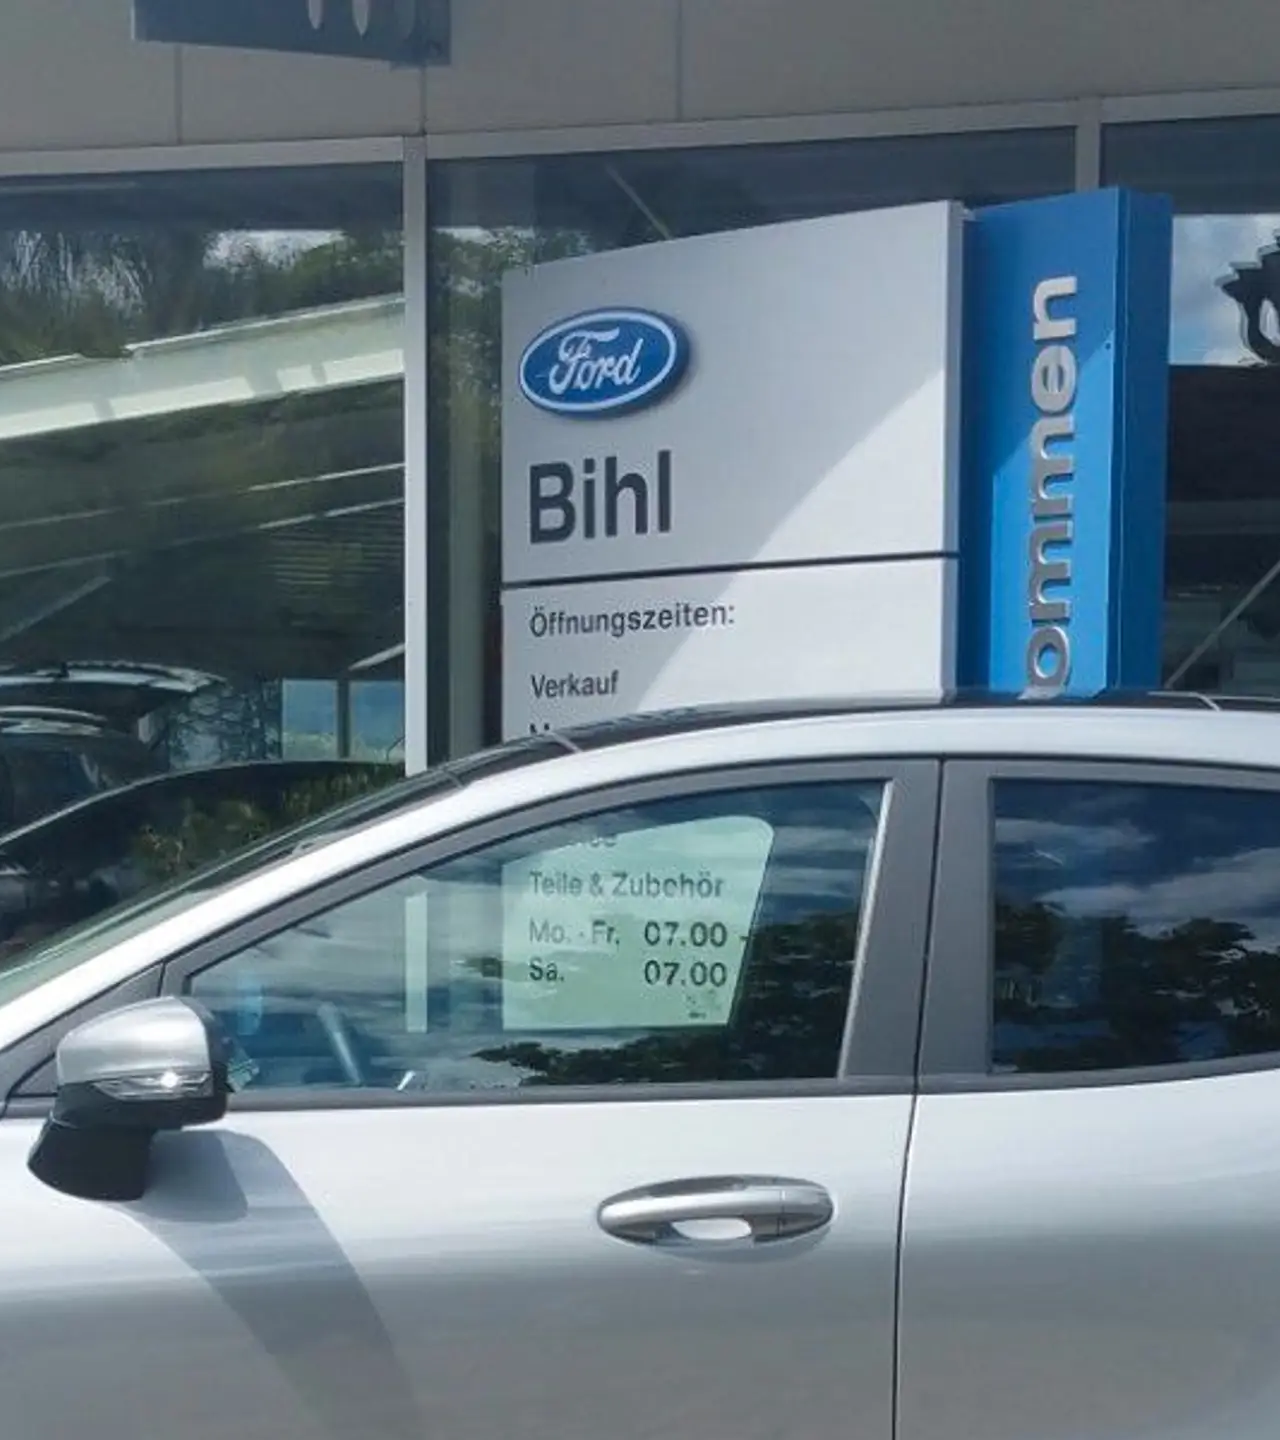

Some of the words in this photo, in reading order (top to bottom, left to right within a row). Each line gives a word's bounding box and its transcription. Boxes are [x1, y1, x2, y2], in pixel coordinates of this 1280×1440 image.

[549, 326, 644, 395] Ford
[528, 449, 672, 544] Bihl
[1017, 276, 1077, 699] ommen
[529, 602, 735, 638] Öffnungszeiten:
[530, 669, 619, 699] Verkauf
[529, 870, 583, 897] Teile
[588, 871, 604, 898] &
[610, 870, 726, 898] Zubehör
[528, 918, 573, 944] Mo.
[643, 920, 728, 948] 07.00
[528, 956, 565, 982] Sa.
[643, 959, 728, 988] 07.00
